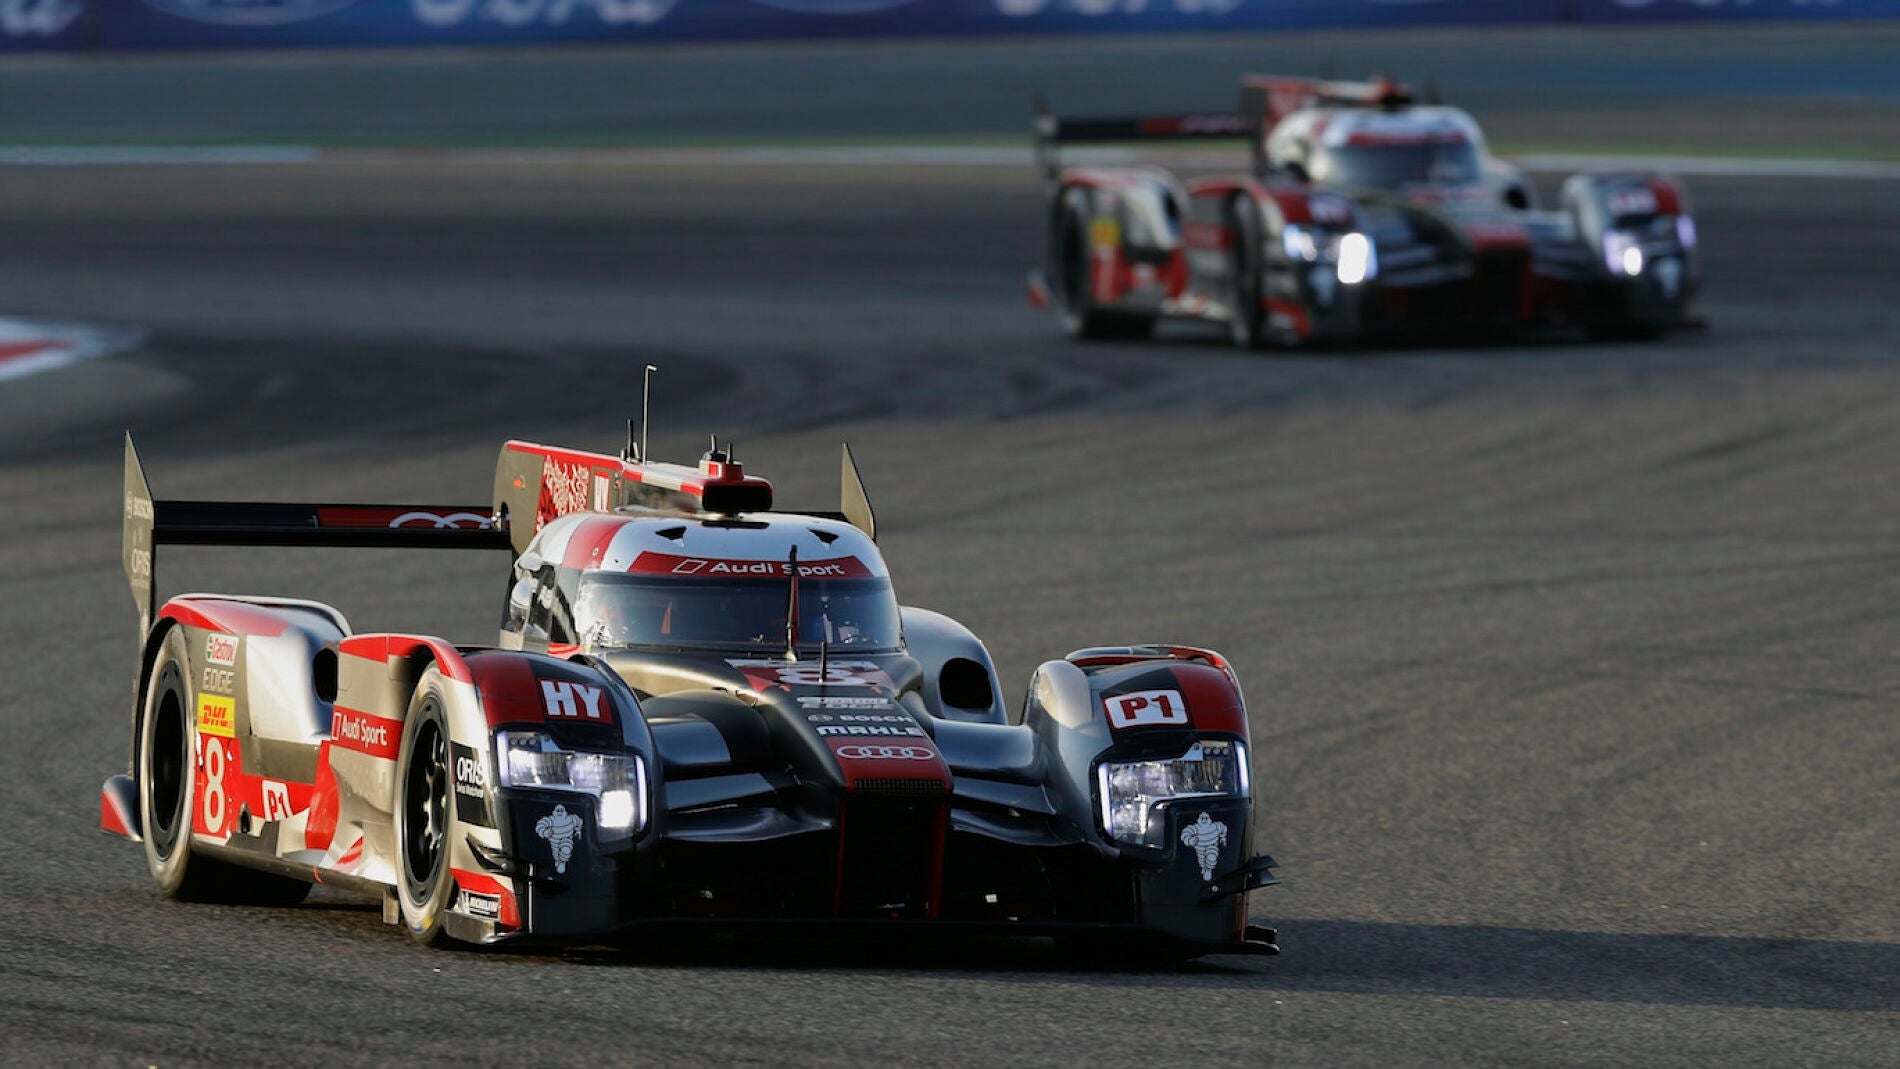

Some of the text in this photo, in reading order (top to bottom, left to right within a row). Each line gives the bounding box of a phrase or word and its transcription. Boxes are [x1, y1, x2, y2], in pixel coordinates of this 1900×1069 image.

[709, 561, 847, 577] Audi Sport
[202, 667, 236, 694] EDGE
[776, 668, 867, 685] 8
[540, 680, 601, 719] HY
[1119, 695, 1175, 720] P1
[201, 704, 228, 727] DHL
[839, 714, 913, 723] BOSCH
[341, 714, 388, 748] Audi Sport
[815, 725, 926, 736] MAHLE
[457, 755, 484, 786] ORIS
[203, 736, 226, 834] 8
[267, 788, 290, 821] P1
